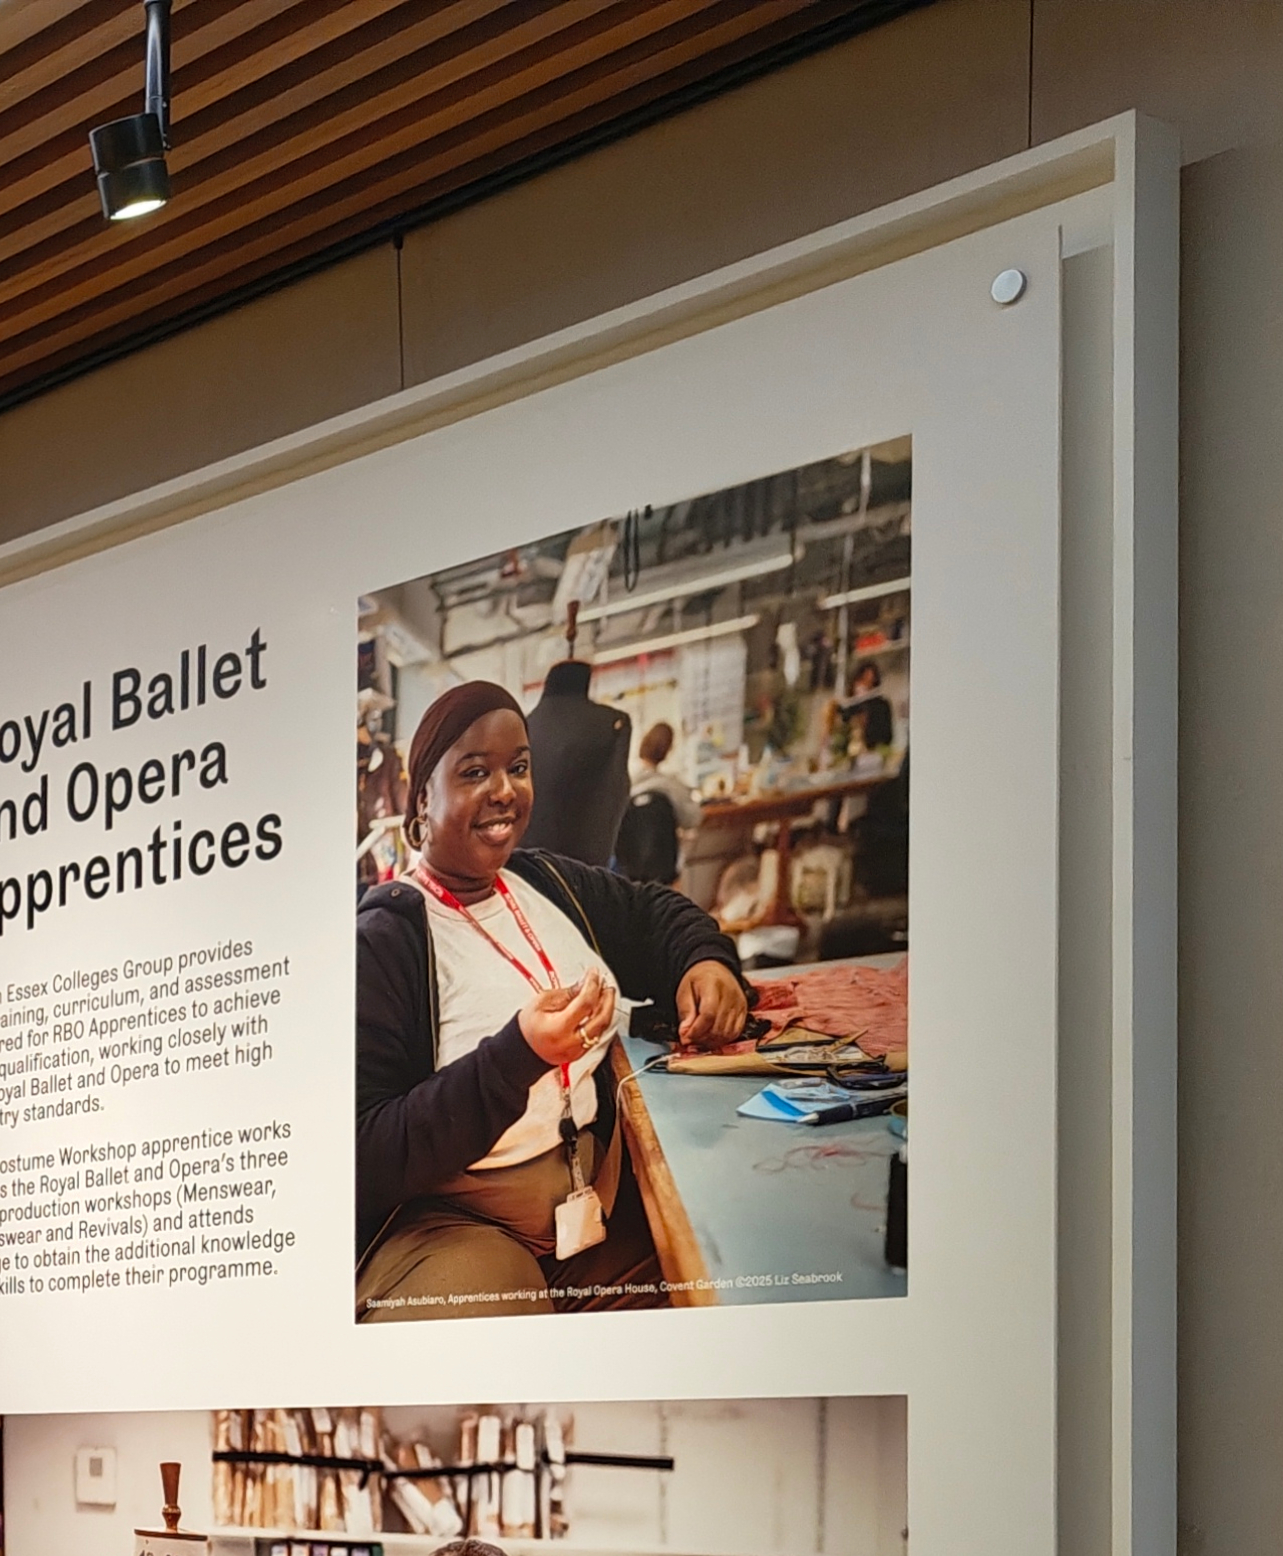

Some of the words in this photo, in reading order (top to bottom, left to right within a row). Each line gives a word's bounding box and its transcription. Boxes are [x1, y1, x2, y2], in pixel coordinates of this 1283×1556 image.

[112, 627, 267, 731] Ballet
[67, 741, 228, 831] Opera
[7, 981, 47, 1002] Essex
[53, 967, 117, 993] Colleges
[123, 956, 172, 978] Group
[178, 939, 252, 973] provides
[53, 989, 144, 1018] curriculum,
[149, 976, 178, 1000] and
[185, 956, 289, 993] assessment
[27, 1025, 48, 1047] for
[53, 1020, 84, 1043] RBO
[89, 1006, 186, 1039] Apprentices
[191, 1000, 207, 1018] to
[213, 989, 280, 1014] achieve
[99, 1035, 162, 1059] working
[168, 1022, 226, 1048] closely
[231, 1014, 267, 1037] with
[31, 1073, 72, 1095] Ballet
[77, 1066, 105, 1088] and
[111, 1054, 159, 1086] Opera
[164, 1057, 180, 1075] to
[186, 1044, 229, 1071] meet
[235, 1040, 271, 1065] high
[23, 1094, 103, 1121] standards.
[59, 1142, 136, 1165] Workshop
[141, 1128, 232, 1159] apprentice
[238, 1120, 290, 1143] works
[11, 1178, 34, 1196] the
[40, 1171, 79, 1196] Royal
[85, 1166, 128, 1188] Ballet
[134, 1160, 163, 1182] and
[169, 1152, 234, 1182] Opera's
[240, 1150, 287, 1170] three
[0, 1198, 79, 1226] production
[84, 1189, 171, 1212] workshops
[176, 1179, 275, 1208] (Menswear,
[46, 1221, 72, 1242] and
[79, 1214, 147, 1238] Revivals)
[153, 1210, 182, 1231] and
[188, 1204, 253, 1228] attends
[14, 1252, 28, 1269] to
[33, 1247, 79, 1267] obtain
[85, 1244, 109, 1263] the
[115, 1235, 194, 1260] additional
[201, 1228, 295, 1253] knowledge
[29, 1276, 43, 1292] to
[48, 1269, 119, 1293] complete
[125, 1264, 164, 1285] their
[169, 1251, 279, 1286] programme.
[448, 1293, 500, 1306] Apprentices
[501, 1290, 536, 1301] working
[538, 1290, 548, 1299] at
[550, 1288, 564, 1298] the
[567, 1285, 592, 1297] Royal
[593, 1283, 623, 1296] Opera
[624, 1281, 658, 1294] House,
[660, 1280, 694, 1292] Covent
[696, 1278, 734, 1290] Garden
[791, 1271, 843, 1284] Seabrook
